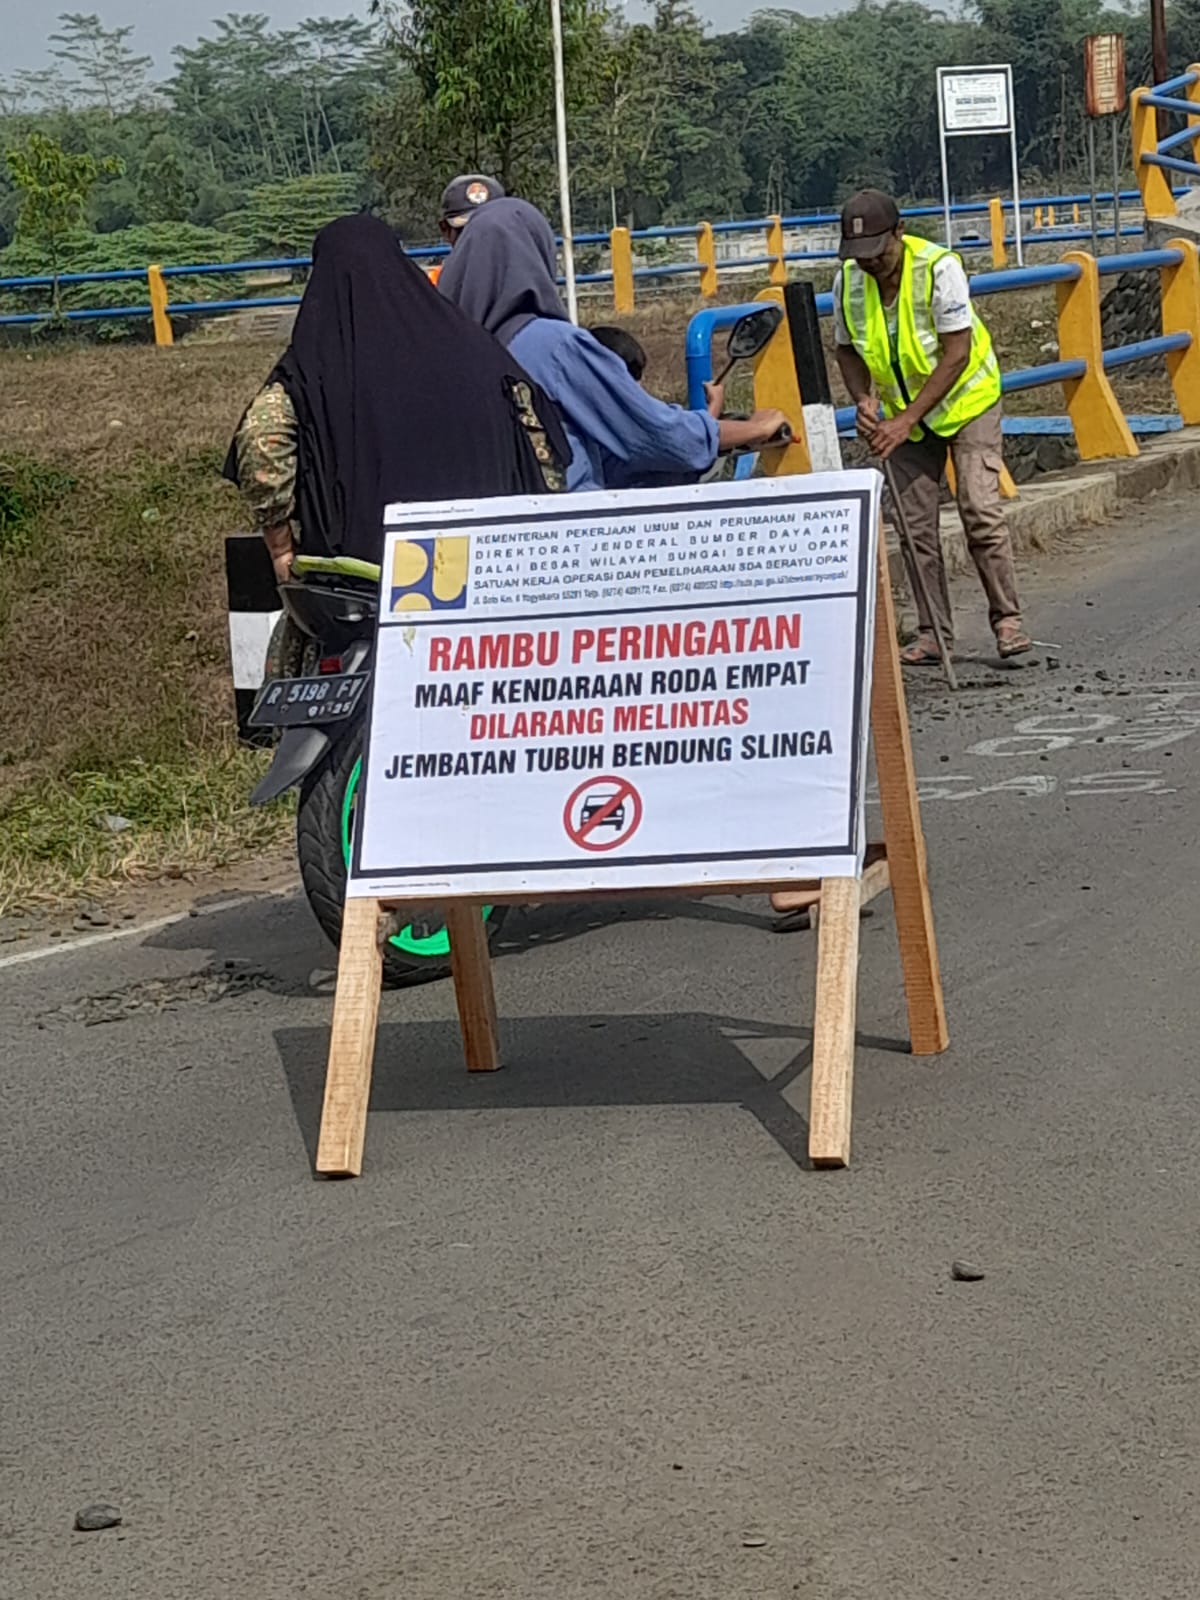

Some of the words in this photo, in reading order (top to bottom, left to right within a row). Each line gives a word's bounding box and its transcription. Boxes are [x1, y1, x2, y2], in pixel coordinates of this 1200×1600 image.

[475, 544, 581, 560] DIREKTORAT
[591, 537, 679, 552] JENDERAL
[689, 531, 758, 545] SUMBER
[769, 527, 811, 540] DAYA
[822, 524, 849, 535] AIR
[476, 530, 559, 545] KEMENTERIAN
[565, 524, 636, 539] PEKERJAAN
[643, 521, 680, 534] UMUM
[687, 519, 712, 531] DAN
[719, 513, 796, 527] PERUMAHAN
[803, 508, 850, 521] RAKYAT
[474, 563, 520, 575] BALAI
[529, 559, 580, 572] BESAR
[590, 554, 657, 567] WILAYAH
[668, 549, 726, 562] SUNGAI
[736, 543, 798, 557] SERAYU
[807, 539, 849, 551] OPAK
[474, 577, 520, 590] SATUAN
[522, 575, 560, 587] KERJA
[563, 571, 614, 584] OPERASI
[616, 568, 641, 580] DAN
[643, 563, 736, 578] PEMELIHARAAN
[738, 562, 762, 572] SDA
[766, 558, 812, 570] SERAYU
[816, 554, 848, 565] OPAK
[428, 630, 560, 672] RAMBU
[571, 613, 801, 665] PERINGATAN
[266, 686, 282, 705] R
[287, 682, 330, 703] 5198
[415, 681, 484, 708] MAAF
[491, 672, 643, 704] KENDARAAN
[650, 667, 717, 695] RODA
[726, 660, 811, 690] EMPAT
[470, 707, 604, 740] DILARANG
[613, 698, 750, 733] MELINTAS
[384, 749, 517, 780] JEMBATAN
[525, 745, 604, 773] TUBUH
[612, 737, 732, 768] BENDUNG
[740, 730, 834, 760] SLINGA
